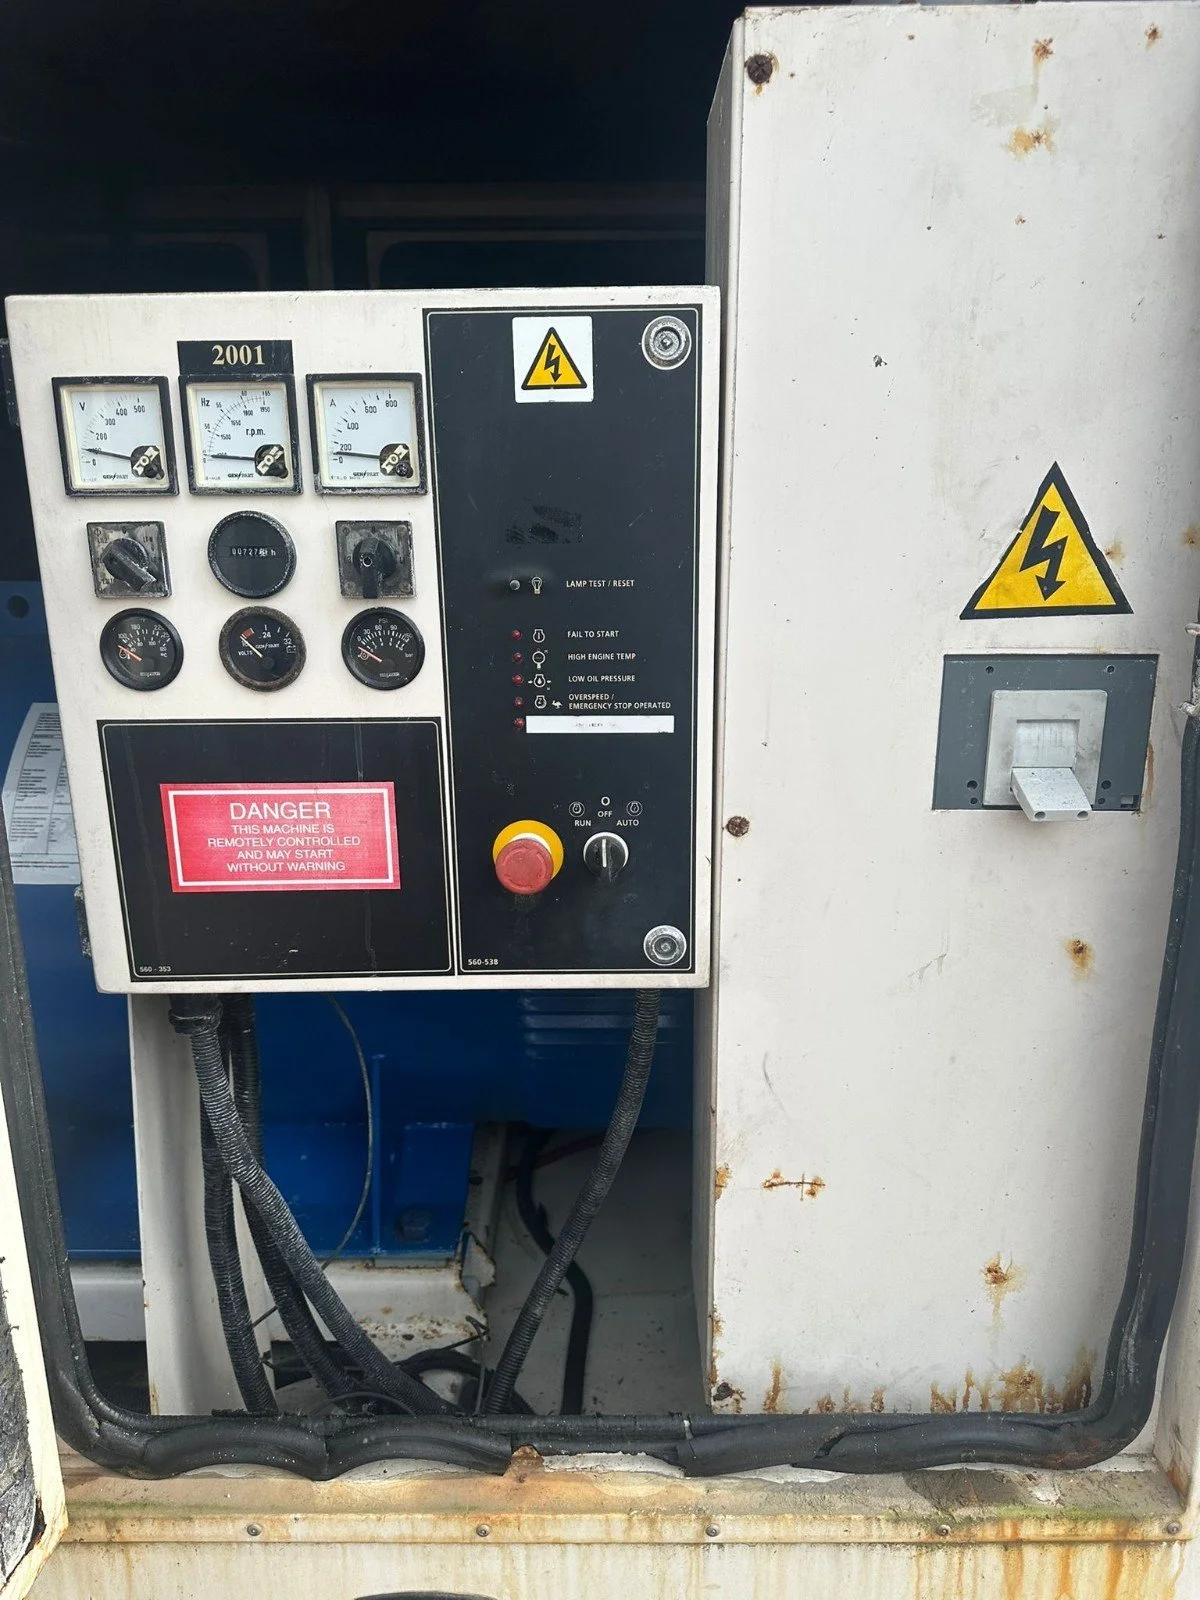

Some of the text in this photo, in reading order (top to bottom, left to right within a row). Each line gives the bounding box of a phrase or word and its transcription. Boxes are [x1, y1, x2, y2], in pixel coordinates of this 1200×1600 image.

[212, 344, 265, 366] 2001
[79, 402, 86, 411] V
[201, 398, 210, 407] Hz
[330, 398, 336, 407] A
[385, 400, 398, 408] 800
[116, 408, 128, 416] 400
[134, 405, 146, 413] 500
[365, 406, 377, 414] 600
[347, 422, 359, 430] 400
[566, 580, 587, 588] LAMP
[569, 702, 611, 710] EMERGENCY
[230, 802, 332, 820] DANGER
[597, 810, 613, 818] OFF
[574, 819, 592, 827] RUN
[231, 824, 334, 834] THIS MACHINE IS
[208, 836, 360, 848] REMOTELY CONTROLLED
[237, 849, 333, 860] AND MAY START
[227, 861, 345, 873] WITHOUT WARNING
